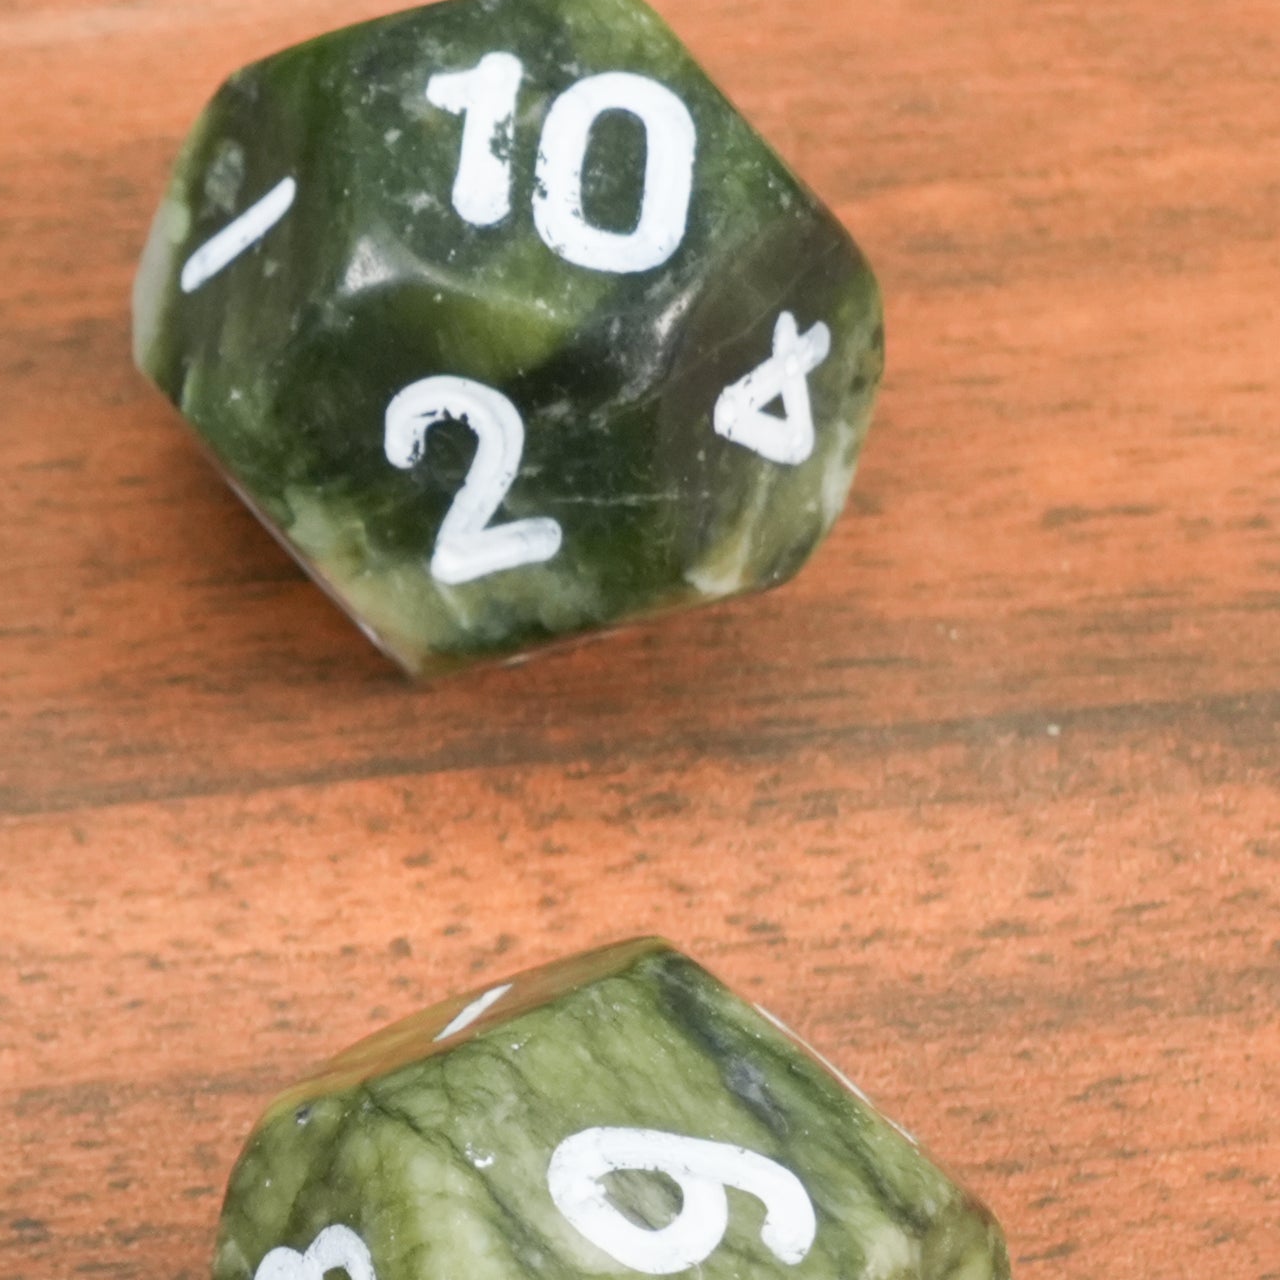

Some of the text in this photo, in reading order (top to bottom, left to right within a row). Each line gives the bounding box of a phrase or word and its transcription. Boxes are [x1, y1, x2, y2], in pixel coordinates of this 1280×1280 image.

[424, 50, 698, 275] 10
[383, 374, 563, 586] 2
[713, 310, 833, 466] 4
